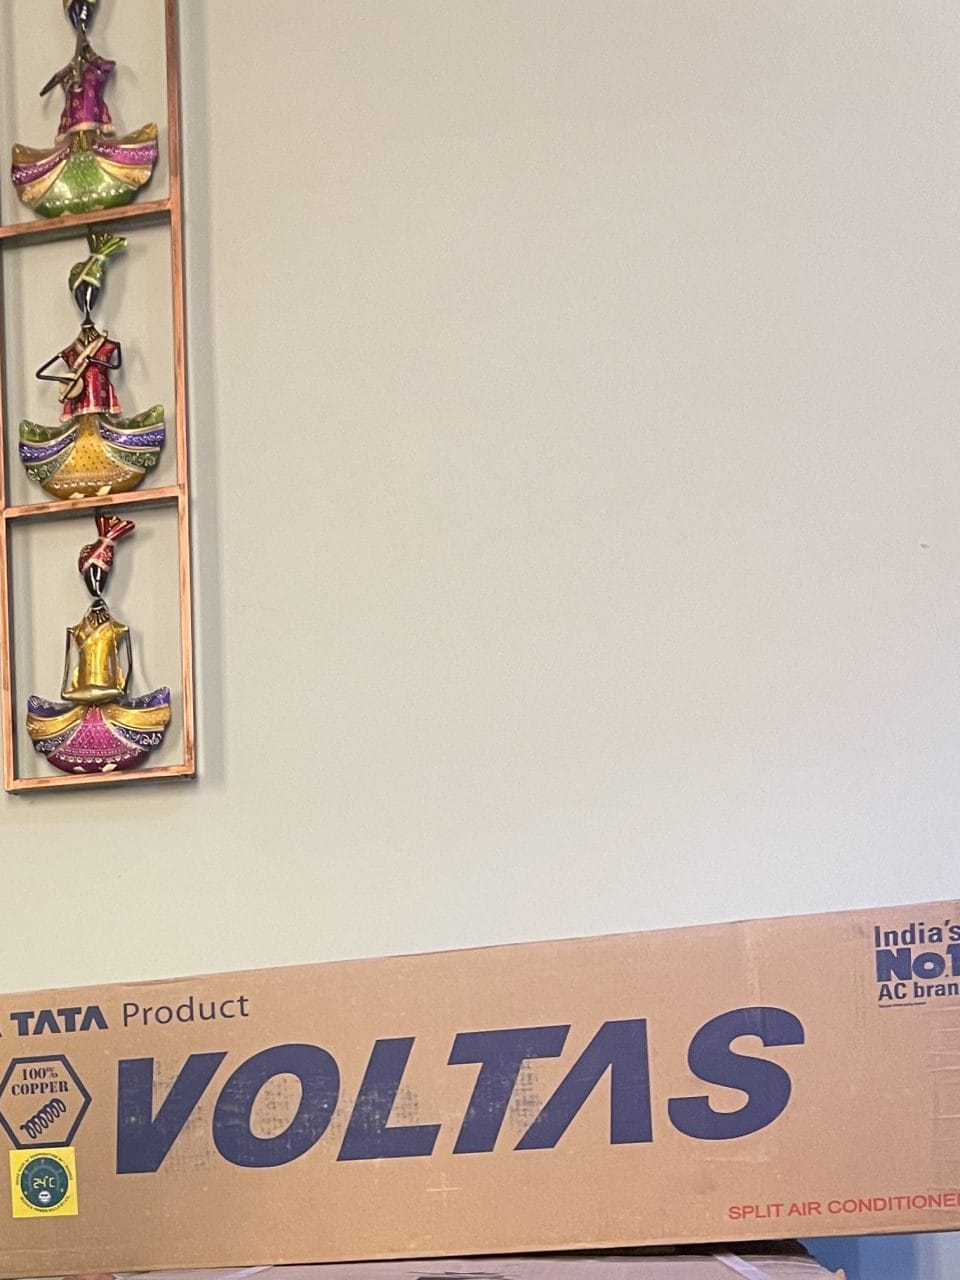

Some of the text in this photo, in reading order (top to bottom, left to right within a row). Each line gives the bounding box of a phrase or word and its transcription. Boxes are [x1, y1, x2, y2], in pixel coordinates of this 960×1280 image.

[878, 981, 959, 1001] AC bran
[10, 1005, 109, 1036] TATA
[123, 995, 249, 1028] Product
[22, 1067, 58, 1081] 100%
[11, 1080, 69, 1096] COPPER
[116, 1006, 805, 1175] VOLTAS
[728, 1192, 960, 1220] SPLIT AIR CONDITIONE
